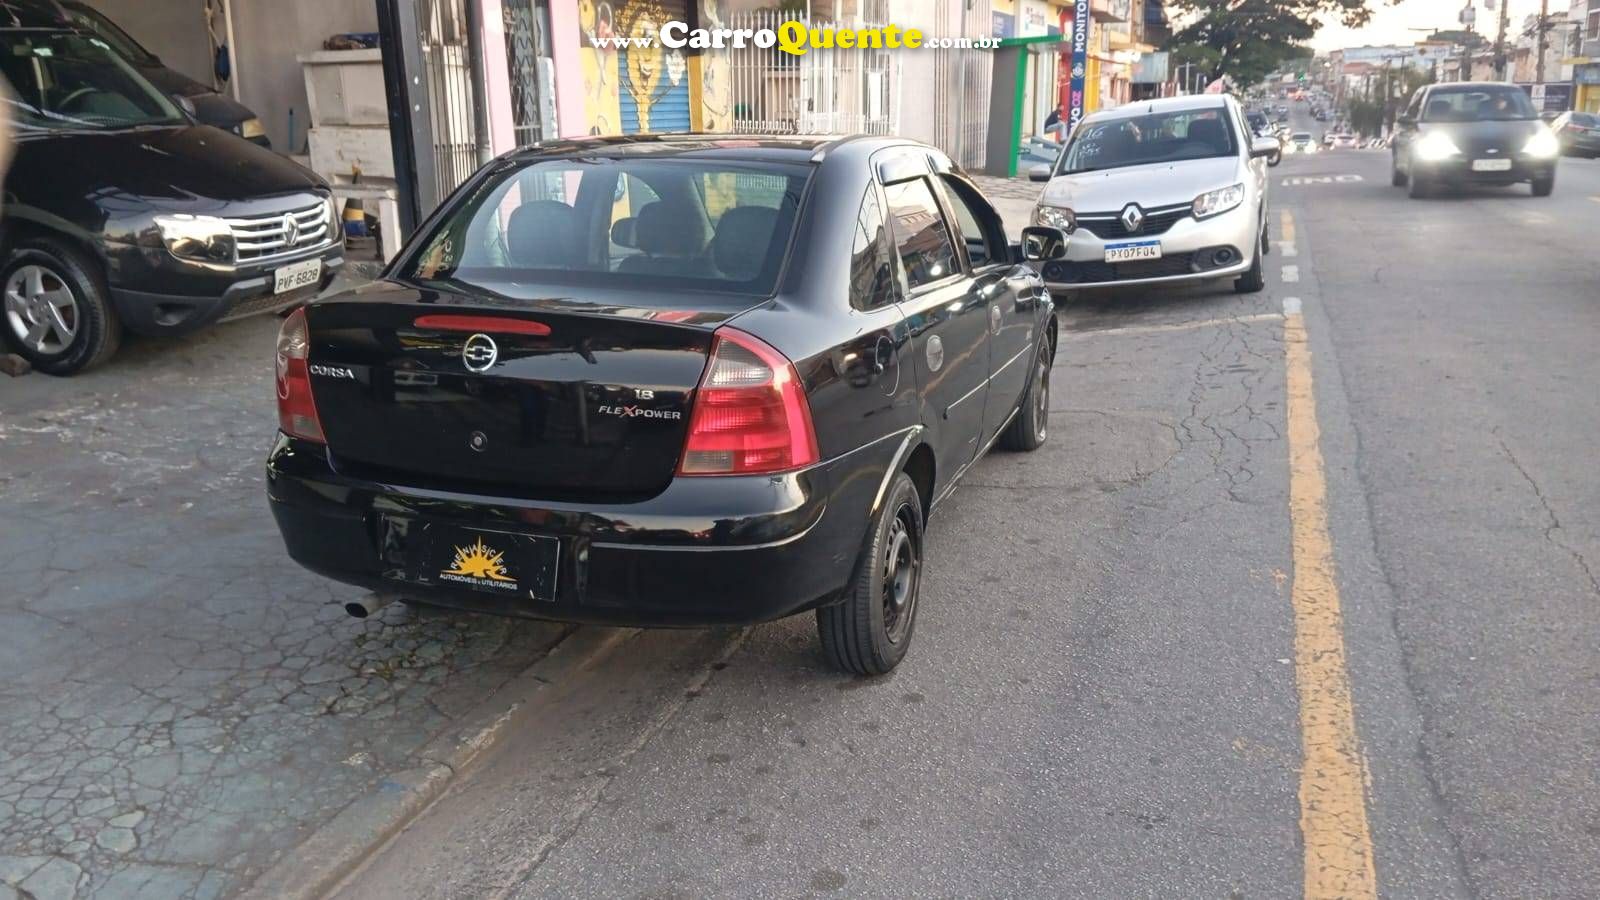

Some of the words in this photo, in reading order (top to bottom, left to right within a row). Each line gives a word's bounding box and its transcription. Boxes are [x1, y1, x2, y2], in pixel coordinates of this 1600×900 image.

[1074, 0, 1087, 52] MONITO
[310, 364, 354, 380] CORSA
[450, 544, 507, 575] RENASCER
